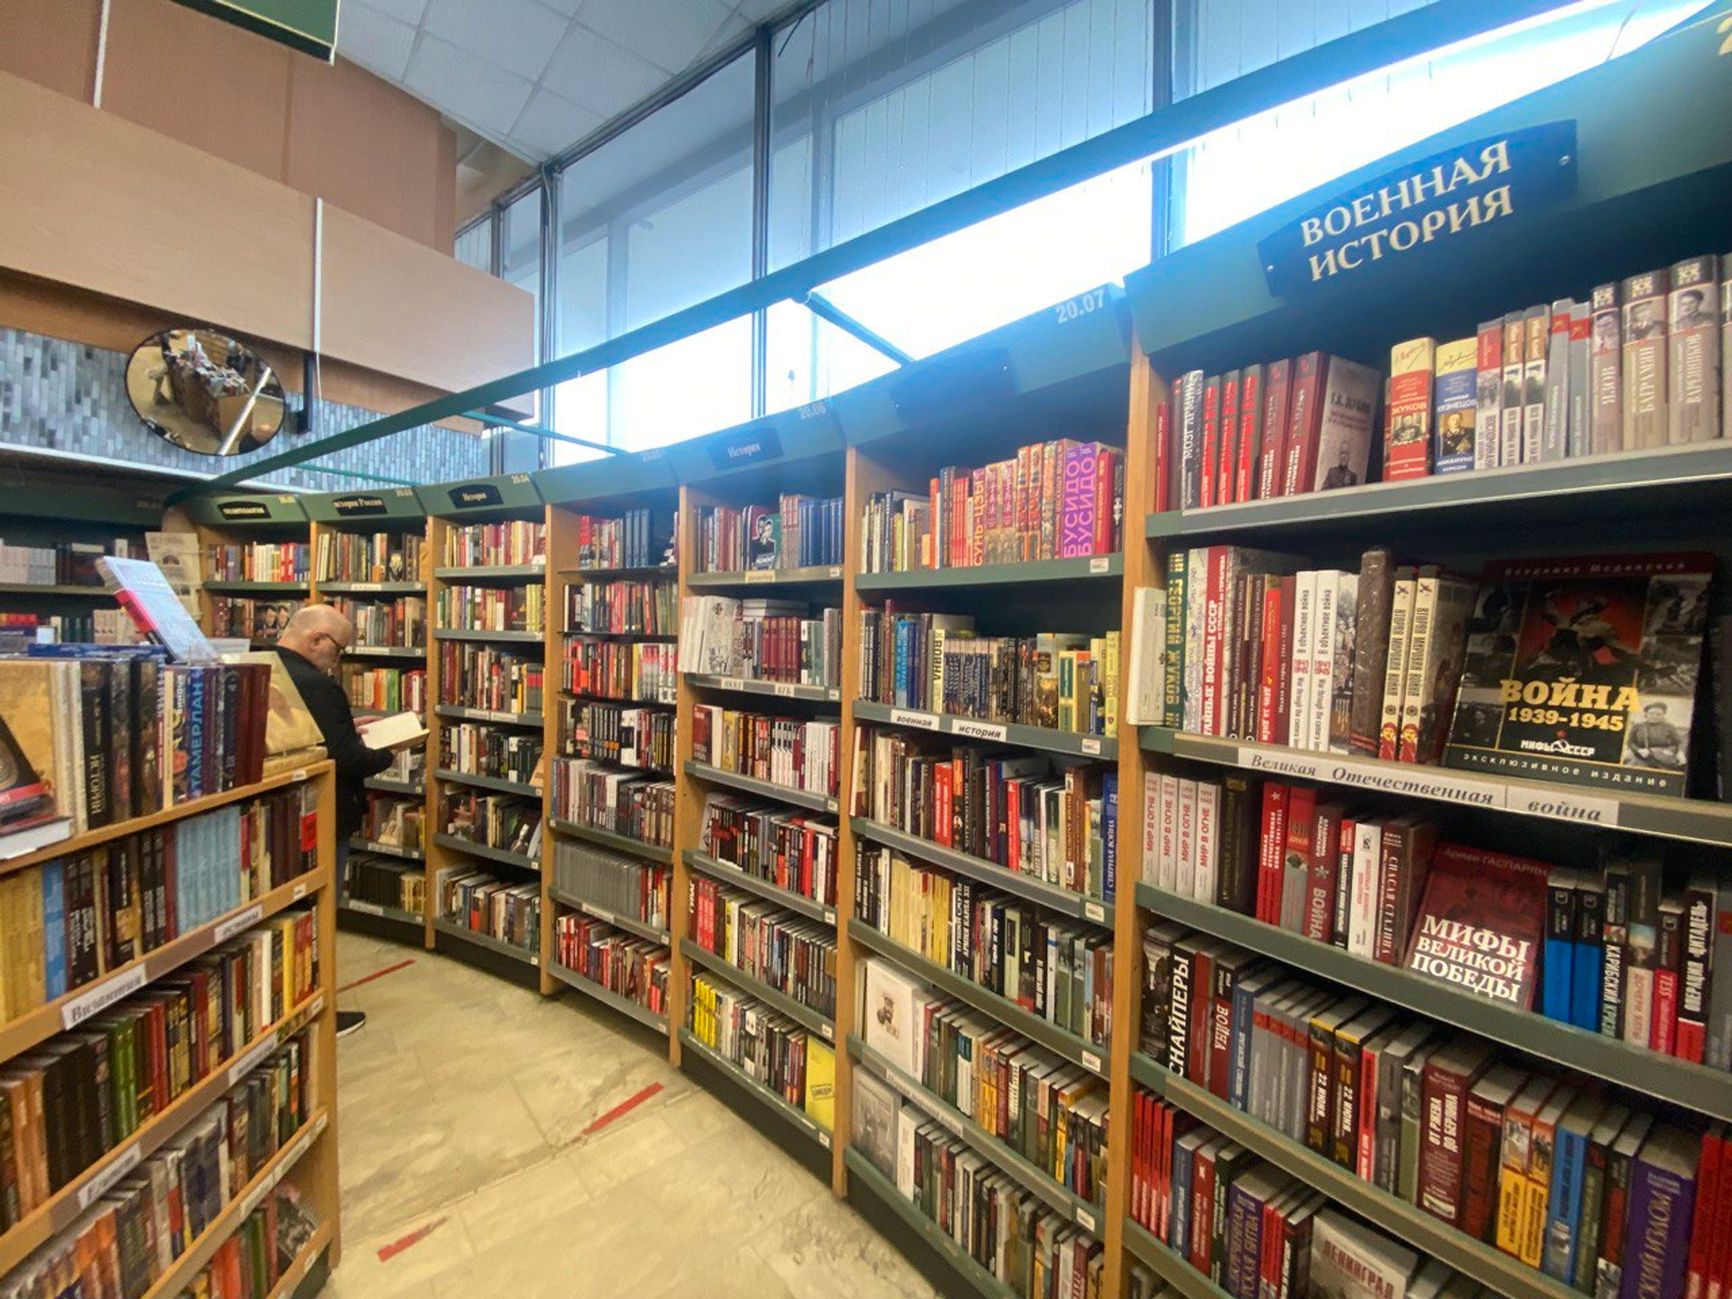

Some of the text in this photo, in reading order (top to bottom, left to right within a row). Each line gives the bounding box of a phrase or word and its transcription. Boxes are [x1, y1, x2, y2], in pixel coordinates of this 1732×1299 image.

[1300, 139, 1512, 248] ВОЕННАЯ
[1308, 184, 1515, 282] ИСТОРИЯ
[1055, 288, 1105, 324] 20.07
[1600, 365, 1617, 405] ЯЗОВ
[1639, 346, 1656, 413] БАГРАМЯН
[1391, 401, 1427, 416] ЖУКОВ
[1184, 429, 1194, 458] МОЗГ
[1064, 460, 1080, 557] БУСИДО
[1078, 457, 1095, 556] БУСИДО
[973, 480, 984, 566] СУНЬ-ЦЗЫ
[1299, 589, 1310, 610] война
[1322, 589, 1332, 610] война
[1166, 579, 1185, 704] ГЕОРГИЙ ЖУКОВ
[1386, 608, 1407, 697] ВТОРАЯ МИРОВАЯ ВОЙНА
[1407, 607, 1429, 697] ВТОРАЯ МИРОВАЯ ВОЙНА
[1203, 599, 1218, 736] ТАЙНЫЕ ВОЙНЫ СССР
[1296, 677, 1304, 687] War
[1261, 686, 1272, 707] ДЕНЬ
[1293, 688, 1303, 708] through
[1317, 678, 1326, 689] War
[1499, 676, 1643, 713] ВОЙНА
[1260, 708, 1271, 718] ЗА
[1294, 710, 1303, 718] the
[1314, 690, 1325, 710] through
[896, 715, 1002, 739] военная история
[1293, 719, 1302, 738] camera
[1314, 720, 1323, 739] camera
[1315, 711, 1324, 720] the
[1508, 706, 1624, 732] 1939-1945
[190, 683, 203, 788] ТАМЕРЛАН
[1521, 740, 1595, 757] МИФЫ СССР
[1250, 753, 1602, 823] Великая Отечественная война
[1591, 769, 1667, 788] издание
[1147, 796, 1156, 820] ОГНЕ
[1164, 800, 1173, 824] ОГНЕ
[1182, 804, 1191, 829] ОГНЕ
[1200, 808, 1210, 834] ОГНЕ
[1106, 819, 1115, 849] ВОЙНА
[1146, 830, 1155, 852] МИР
[1163, 835, 1172, 857] МИР
[1181, 840, 1191, 863] МИР
[1199, 845, 1209, 867] МИР
[1482, 855, 1549, 876] ГАСПАРЯН
[1385, 856, 1399, 901] СПАСАЯ
[1308, 887, 1328, 941] ВОЙНА
[1381, 904, 1397, 956] СТАЛИНА
[1422, 913, 1531, 962] МИФЫ
[1416, 937, 1526, 982] ВЕЛИКОЙ
[1604, 944, 1622, 1003] КАРИБСКИЙ
[1410, 952, 1521, 1002] ПОБЕДЫ
[1659, 974, 1674, 998] TESS
[1684, 961, 1704, 1013] ОПЕРАЦИЯ
[1631, 974, 1646, 1011] ДОЧЕРИ
[1167, 955, 1190, 1078] СНАЙПЕРЫ
[1213, 1004, 1231, 1050] ВОЙНА
[1601, 1004, 1618, 1037] КРИЗИ
[1318, 1072, 1328, 1085] 22
[1343, 1085, 1353, 1099] 22
[1428, 1097, 1442, 1144] ОТ РЖЕВА
[1444, 1094, 1459, 1153] ДО БЕРЛИНА
[1642, 1189, 1671, 1249] ИЗЛОМ
